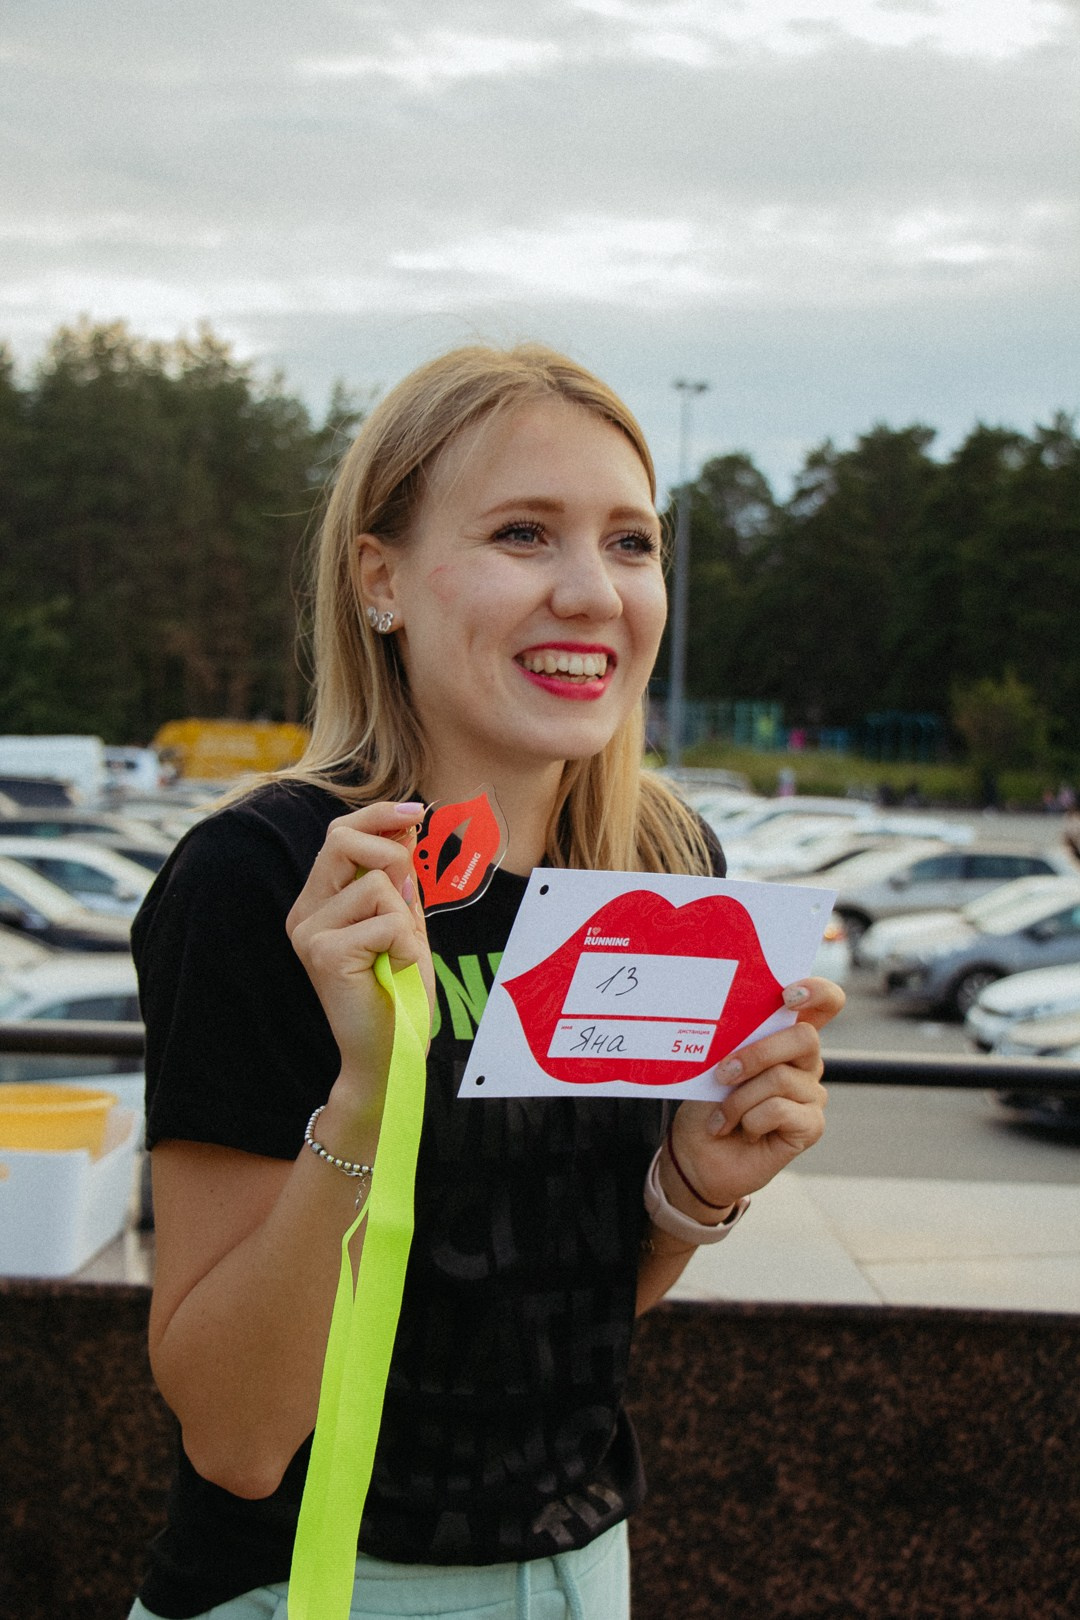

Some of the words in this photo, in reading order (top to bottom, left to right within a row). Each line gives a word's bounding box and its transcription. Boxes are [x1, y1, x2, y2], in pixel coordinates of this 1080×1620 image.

[457, 852, 481, 891] RUNNING
[584, 936, 630, 947] RUNNING
[587, 927, 592, 936] I
[596, 966, 638, 996] 13
[570, 1026, 627, 1053] Яна
[671, 1040, 682, 1053] 5
